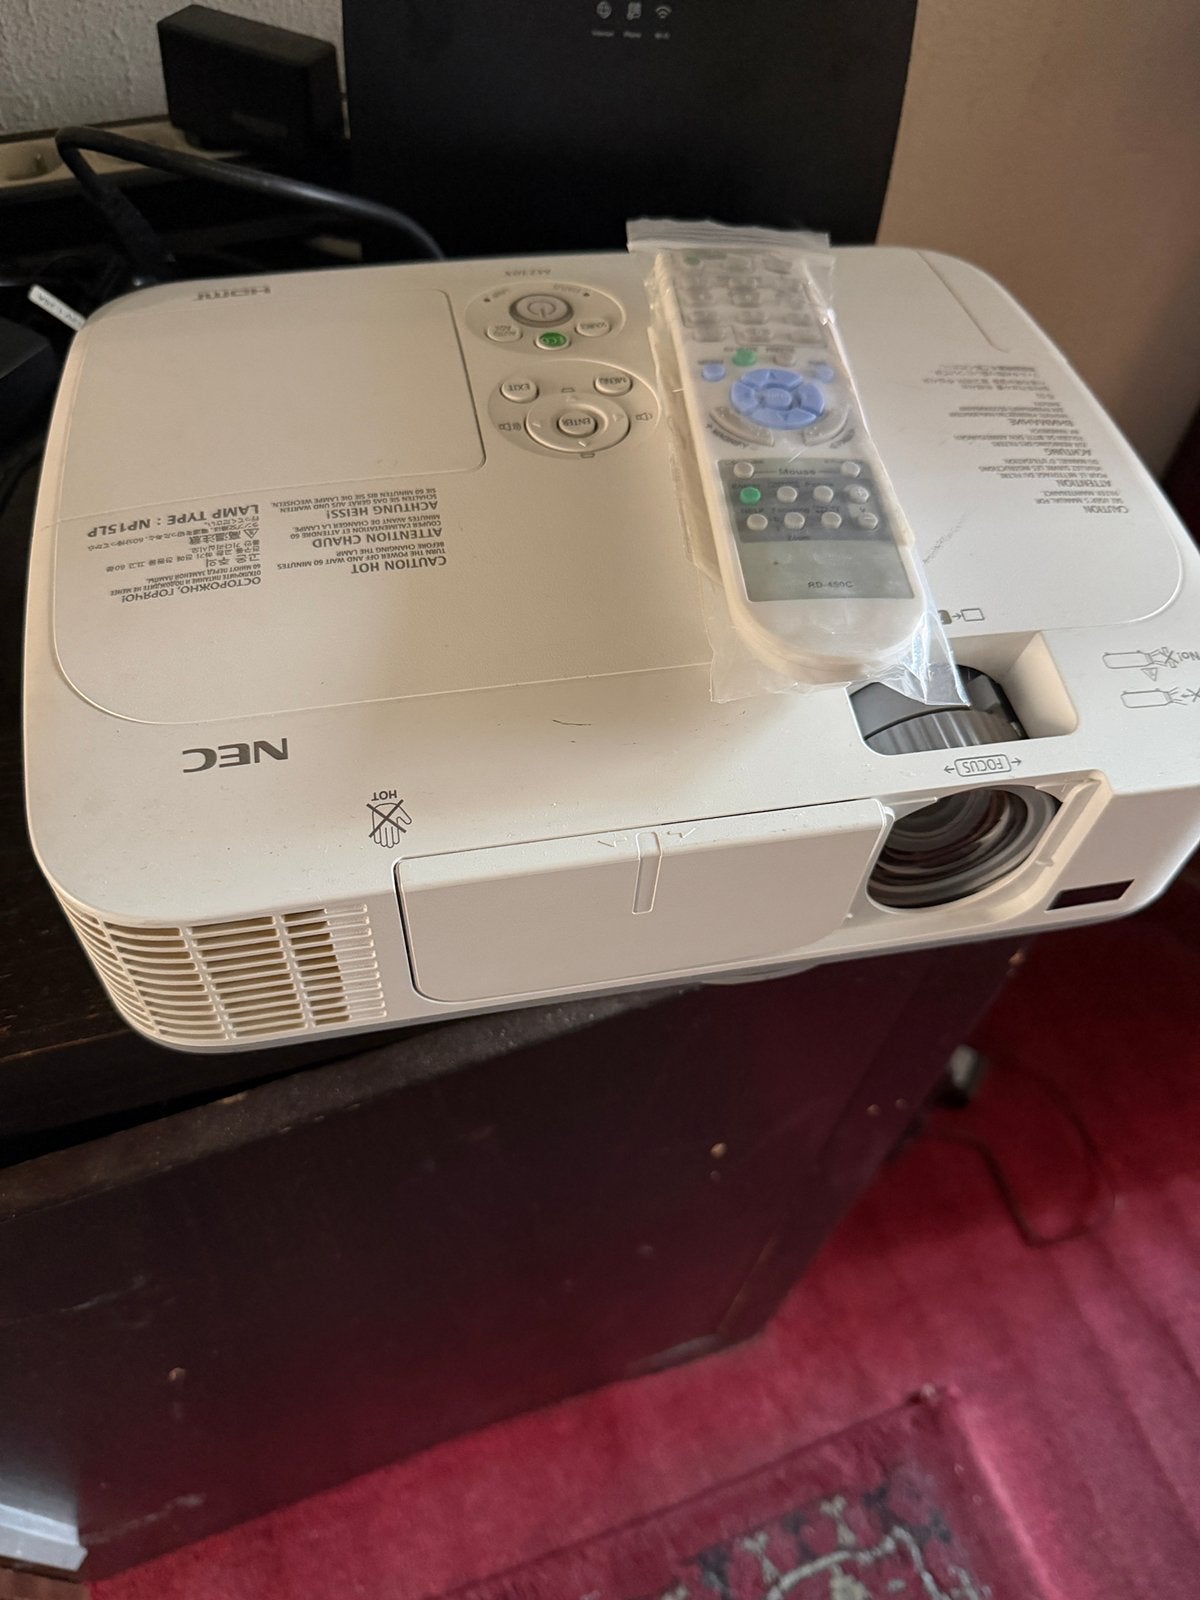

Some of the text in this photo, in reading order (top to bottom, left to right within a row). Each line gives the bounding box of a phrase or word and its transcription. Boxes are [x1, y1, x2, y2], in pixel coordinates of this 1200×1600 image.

[508, 383, 530, 392] EXIT
[561, 418, 592, 426] ENTER
[380, 489, 413, 498] MINUTEN
[402, 493, 437, 502] SCHALTEN
[271, 498, 312, 507] WECHSELN.
[313, 496, 339, 504] LAMPE
[212, 504, 259, 519] LAMP
[280, 505, 312, 513] WARTEN
[326, 500, 438, 519] ACHTUNG HEISS!
[1083, 505, 1128, 514] CAUTION
[167, 511, 207, 525] TYPE
[88, 519, 150, 538] NP15LP
[293, 524, 320, 532] LAMPE.
[333, 520, 369, 530] CHANGER
[352, 523, 410, 533] L'ALIMENTATION
[412, 520, 441, 528] COUPER
[302, 529, 340, 538] ATTENDRE
[312, 528, 442, 548] ATTENTION CHAUD
[376, 544, 415, 552] CHANGING
[381, 551, 408, 559] POWER
[206, 553, 260, 568] 고온 주의
[351, 556, 446, 574] CAUTION HOT
[277, 561, 312, 570] MINUTES
[175, 570, 206, 580] ЗАМЕНОЙ
[207, 567, 228, 575] ПЕРЕД
[222, 570, 261, 578] ОТКЛЮЧИТЕ
[192, 575, 221, 583] ПИТАНИЕ
[121, 577, 261, 602] ОСТОРОЖНО, ГОРЯЧО!
[143, 580, 184, 592] ПОДОЖДИТЕ
[110, 588, 132, 596] МЕНЕЕ
[1177, 650, 1200, 662] No!
[182, 738, 288, 773] NEC
[962, 758, 1003, 773] FOCUS
[371, 790, 398, 801] HOT
